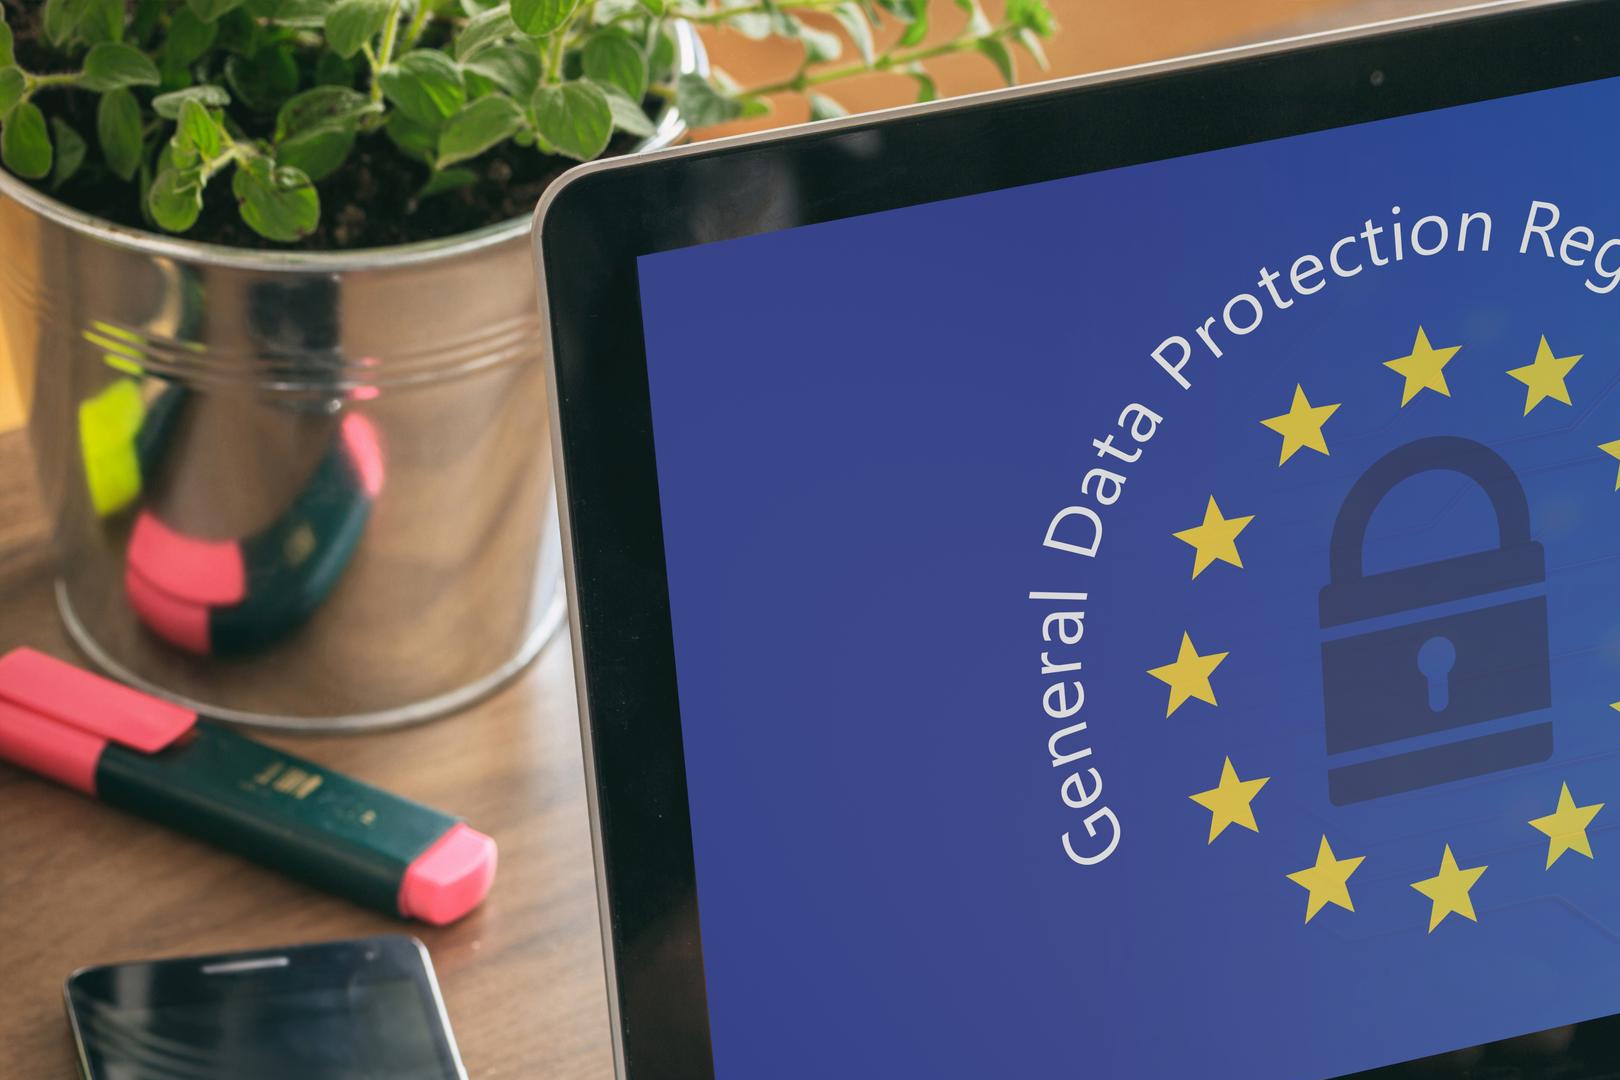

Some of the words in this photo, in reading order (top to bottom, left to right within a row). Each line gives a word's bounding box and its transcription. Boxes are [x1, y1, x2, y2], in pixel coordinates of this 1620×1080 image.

[1150, 206, 1492, 390] Protection
[1042, 403, 1163, 558] Data
[1028, 591, 1121, 867] General
